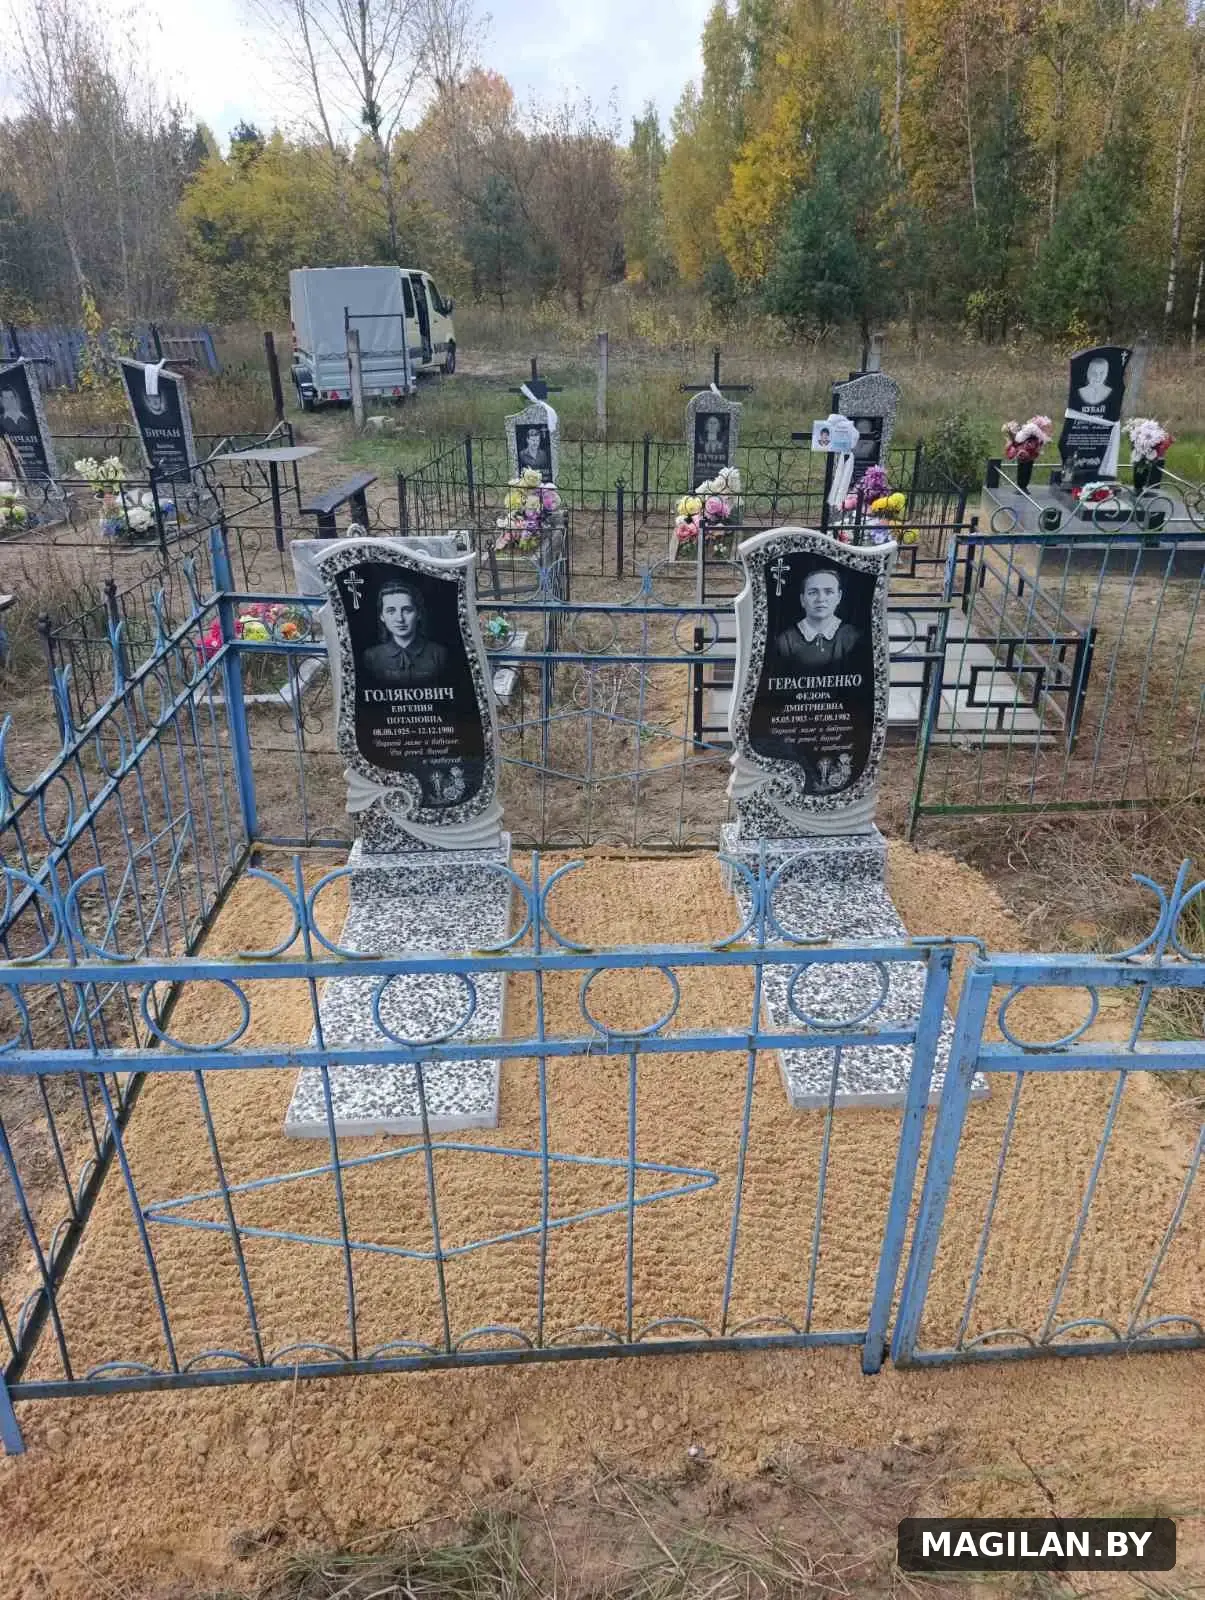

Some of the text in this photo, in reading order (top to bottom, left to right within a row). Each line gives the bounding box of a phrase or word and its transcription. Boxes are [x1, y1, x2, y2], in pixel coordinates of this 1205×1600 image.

[144, 427, 181, 439] БИЧАН
[767, 673, 863, 691] ГЕРАСИМЕНКО
[364, 687, 454, 702] ГОЛЯКОВИЧ
[795, 692, 831, 701] ФЕДОРА
[391, 704, 433, 713] ЕВГЕНИЯ
[783, 702, 844, 713] ДМИТРИЕВНА
[386, 715, 443, 725] ПОТАПОВНА
